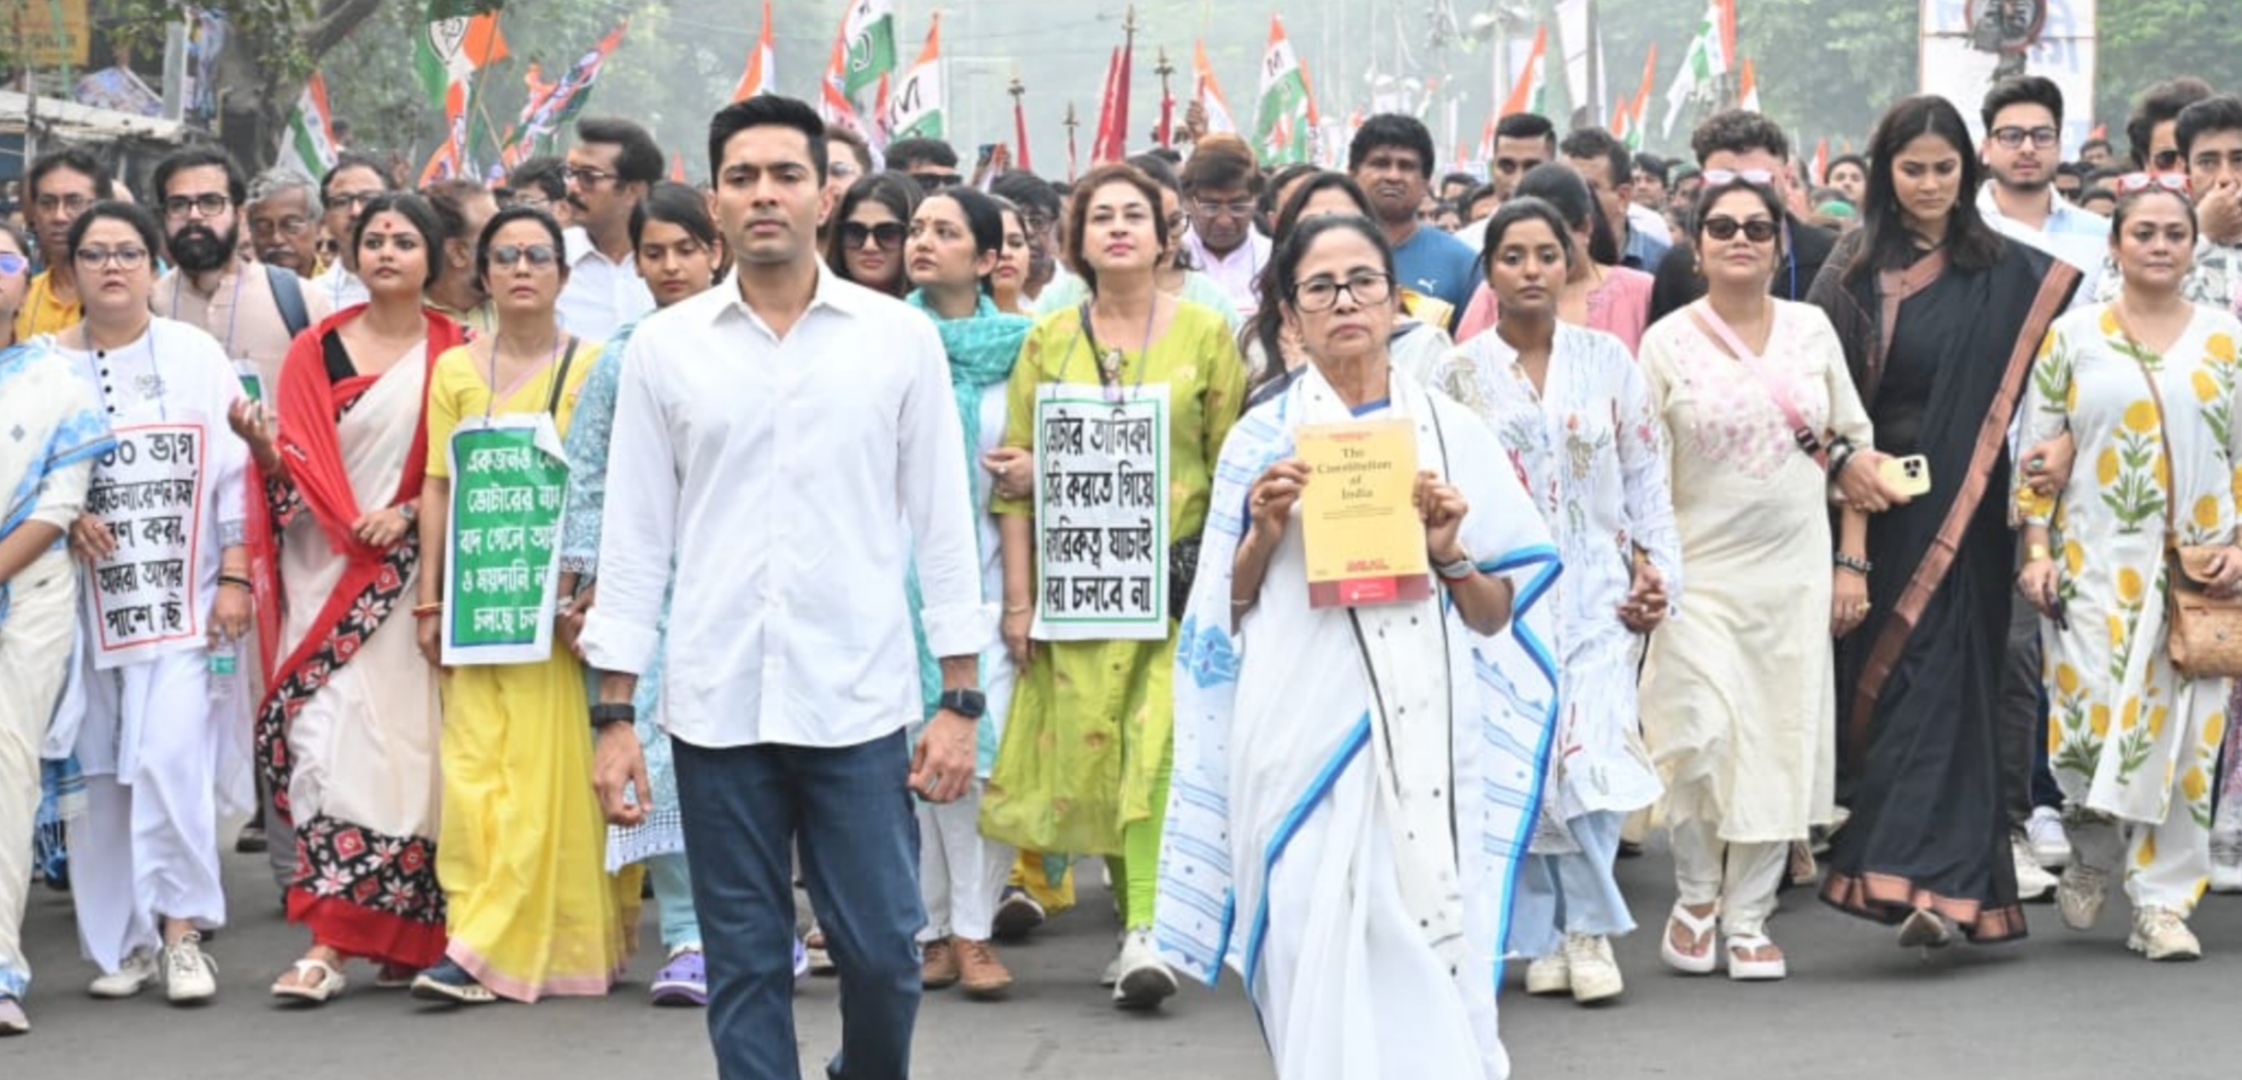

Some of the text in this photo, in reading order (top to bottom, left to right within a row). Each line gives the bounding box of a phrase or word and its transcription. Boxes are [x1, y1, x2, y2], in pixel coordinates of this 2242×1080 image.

[1090, 408, 1153, 454] তালিকা
[146, 432, 195, 464] ভাগ
[1341, 447, 1366, 459] The
[1317, 460, 1392, 474] Constitution
[467, 481, 534, 513] ভোটারের
[1066, 472, 1113, 507] করতে
[1118, 461, 1155, 508] গিয়ে
[1341, 487, 1374, 500] India
[1109, 517, 1153, 564] যাচাই
[1072, 575, 1124, 614] চলবে
[1130, 575, 1152, 613] না
[105, 604, 155, 637] পাশে
